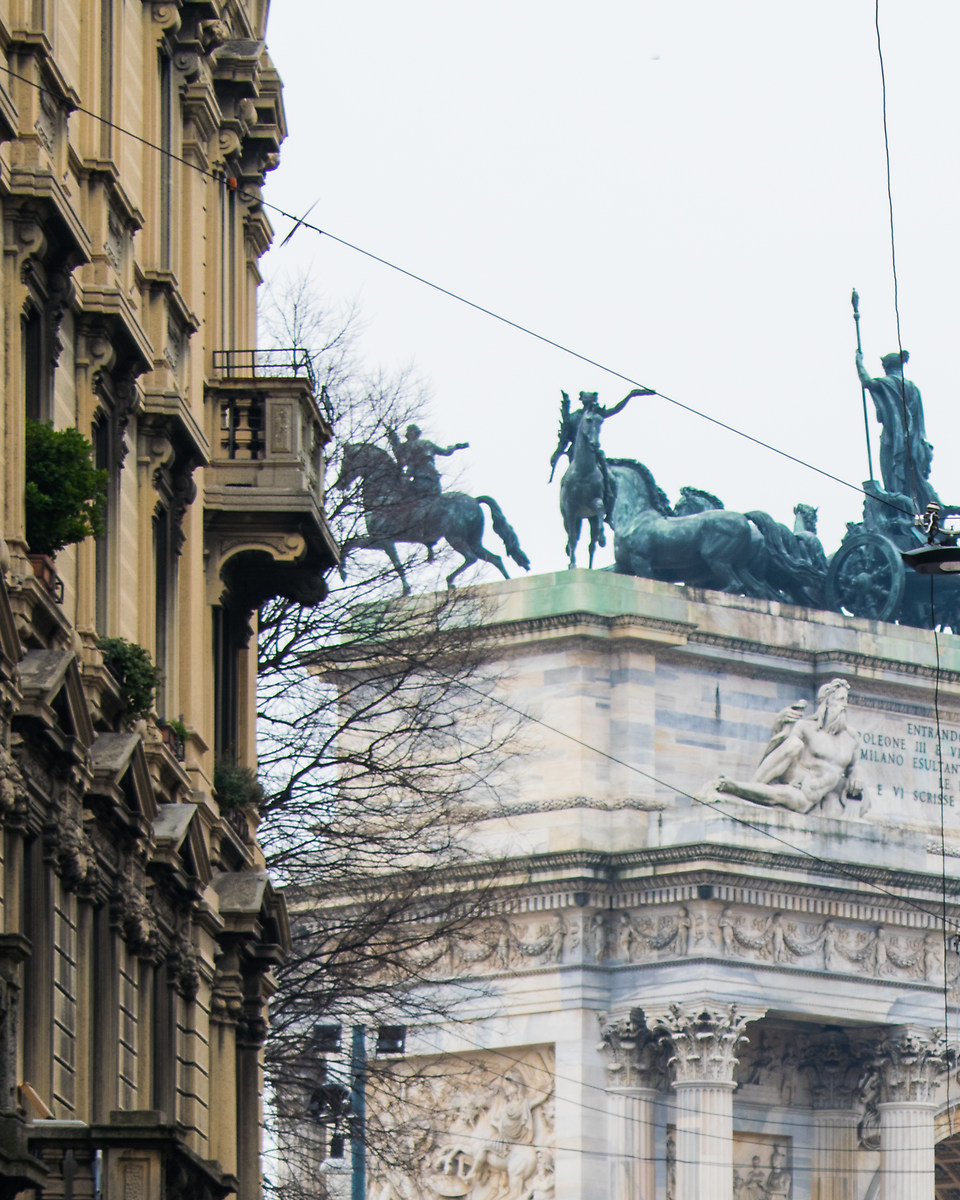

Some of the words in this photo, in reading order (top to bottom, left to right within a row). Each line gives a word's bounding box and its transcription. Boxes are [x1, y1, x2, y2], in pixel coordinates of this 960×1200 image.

[915, 741, 926, 754] III
[860, 748, 904, 767] MILANO
[938, 777, 950, 790] LE
[876, 783, 883, 796] E
[892, 786, 904, 799] VI
[912, 790, 955, 807] SCRISSE
